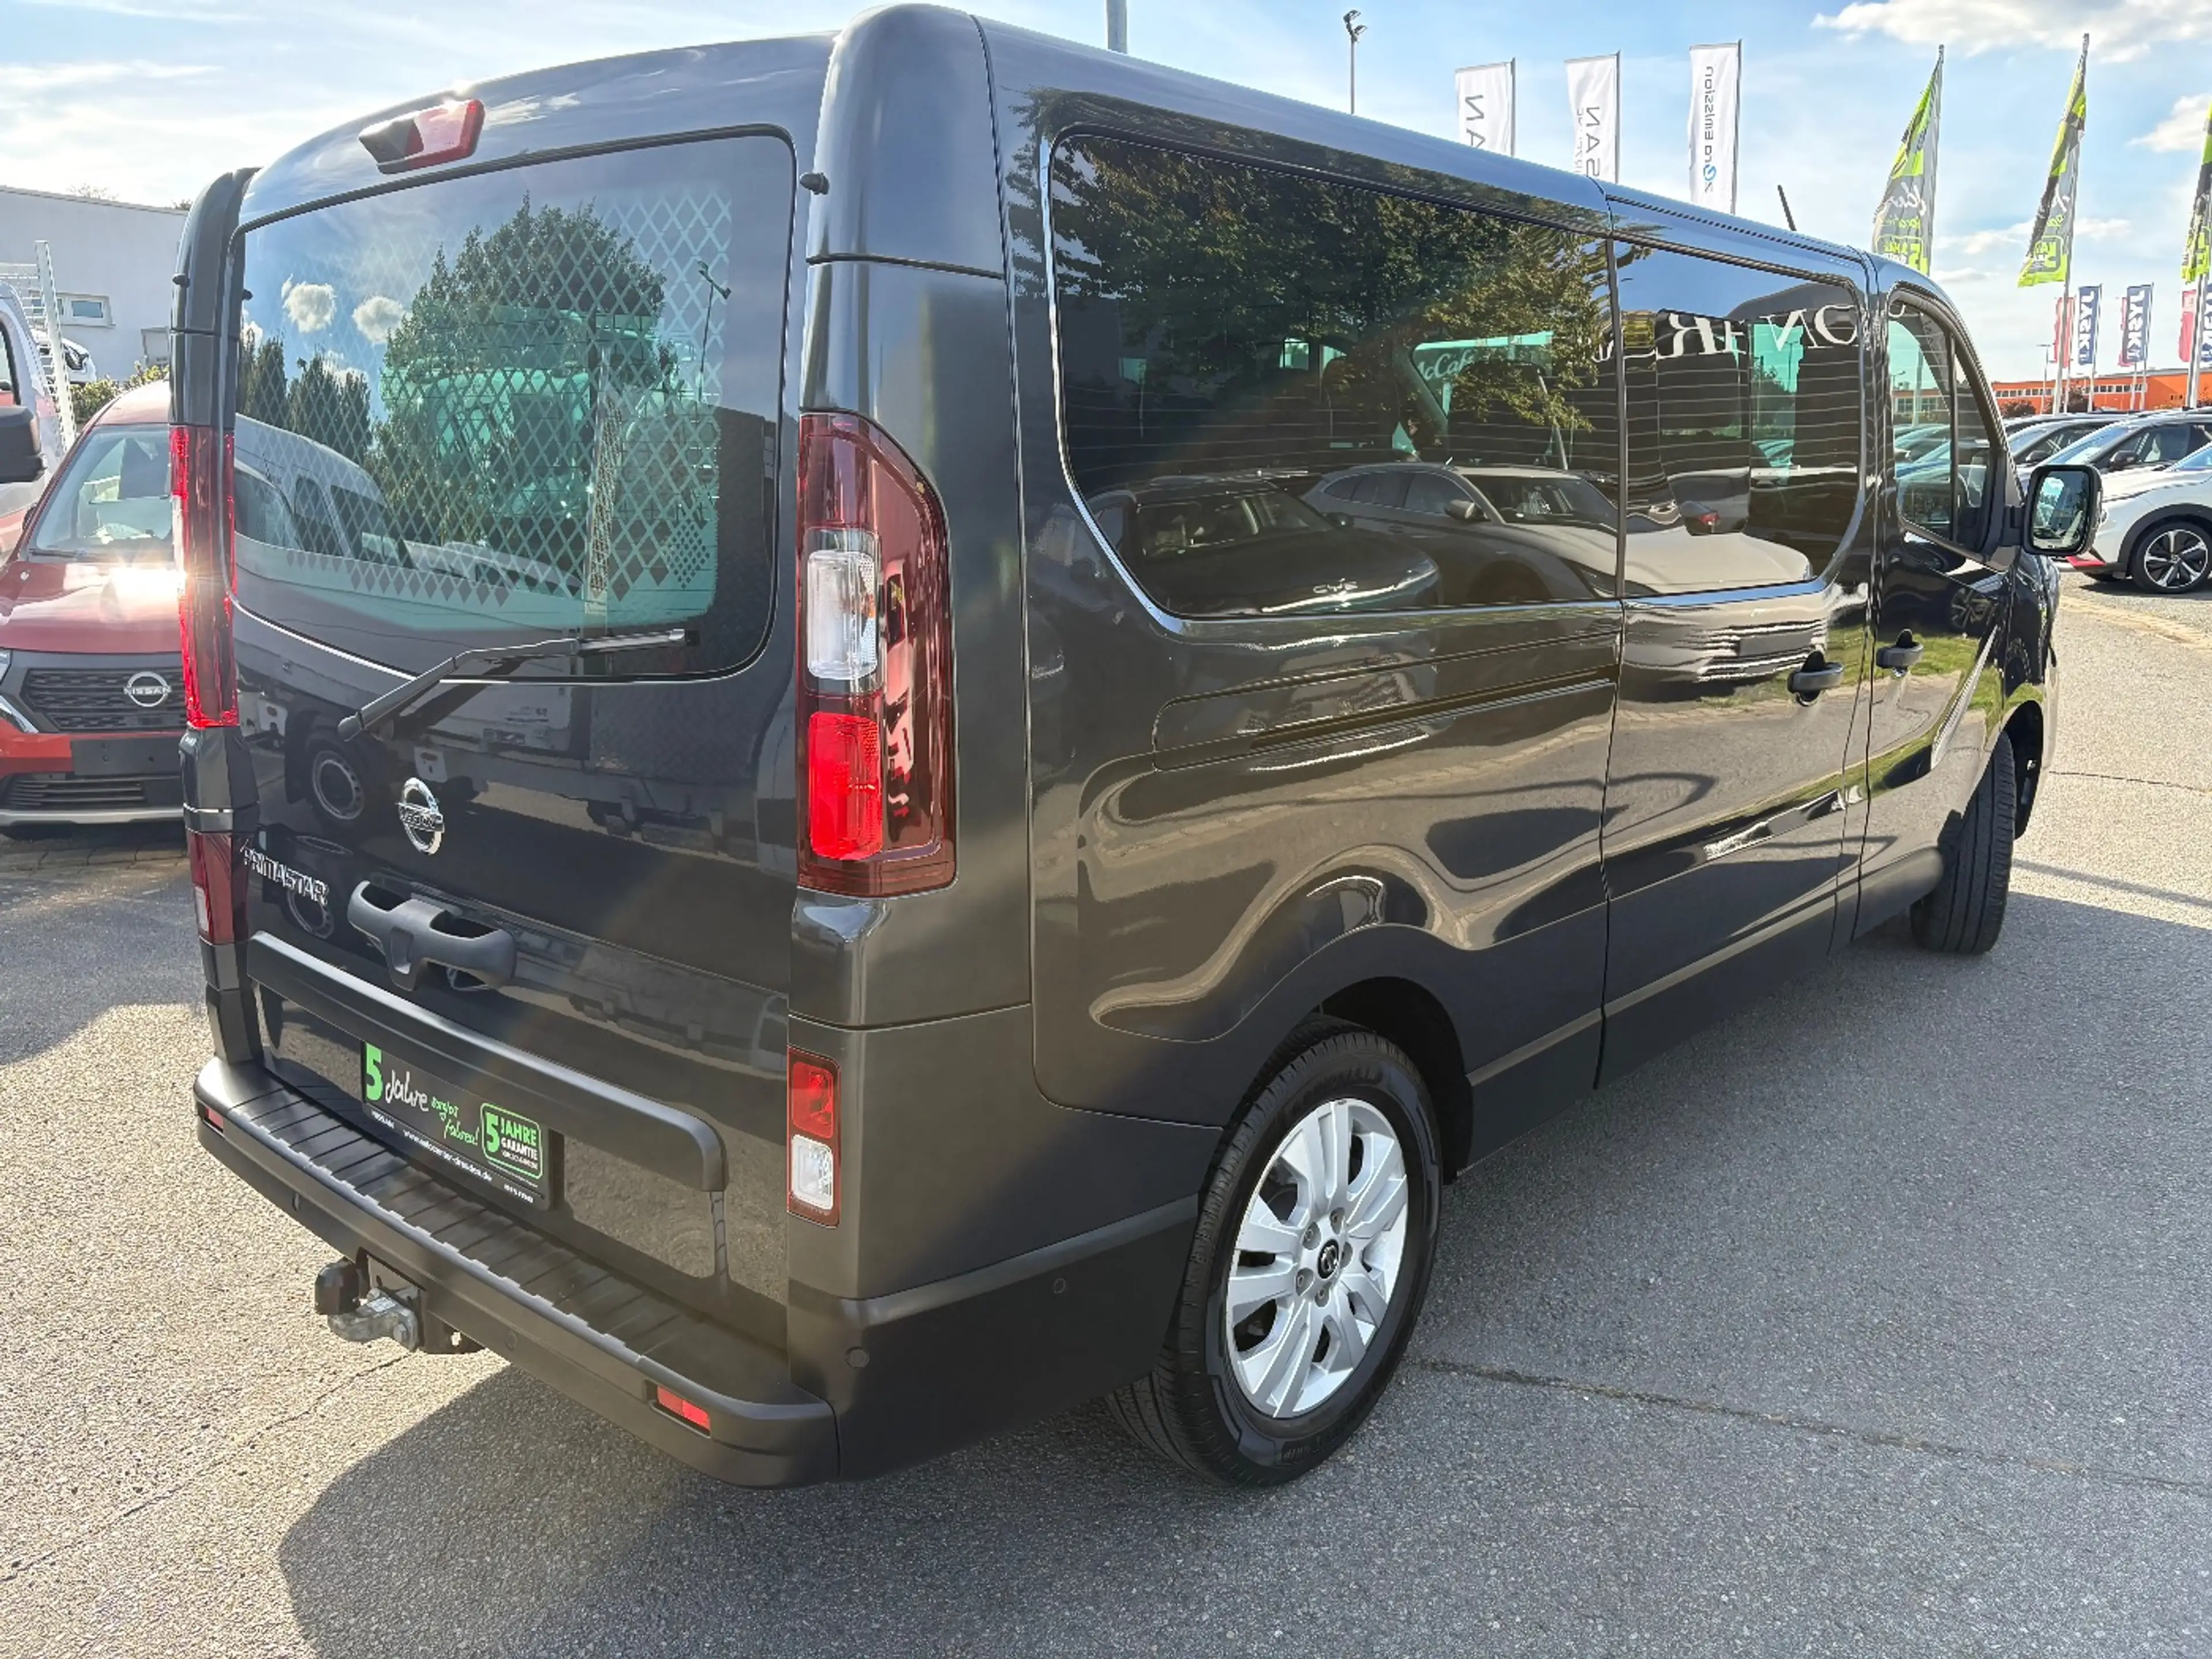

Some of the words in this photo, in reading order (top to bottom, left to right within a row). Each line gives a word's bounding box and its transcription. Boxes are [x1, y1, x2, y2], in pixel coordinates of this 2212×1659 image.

[366, 1043, 382, 1101] 5
[385, 1070, 429, 1112] Jahre
[486, 1112, 499, 1152] 5
[501, 1117, 537, 1146] JAHRE
